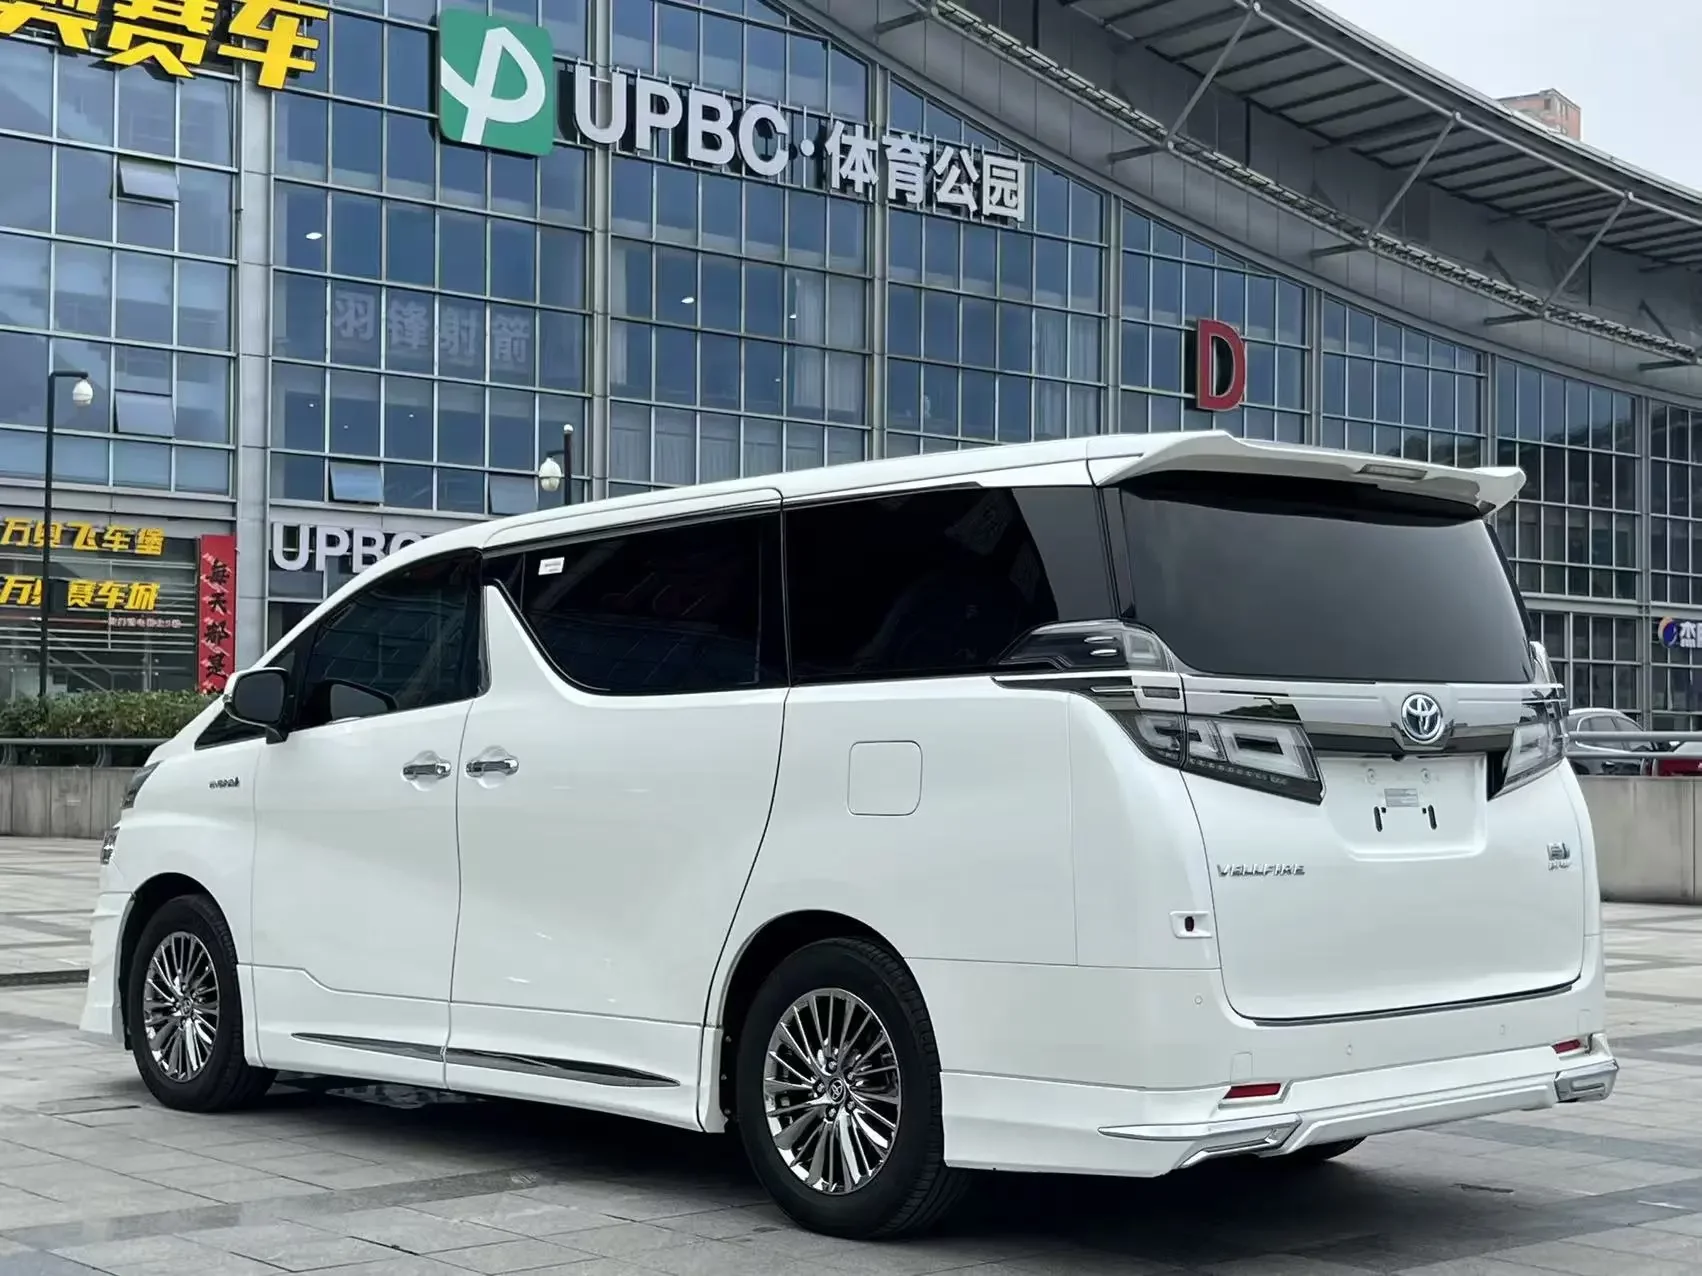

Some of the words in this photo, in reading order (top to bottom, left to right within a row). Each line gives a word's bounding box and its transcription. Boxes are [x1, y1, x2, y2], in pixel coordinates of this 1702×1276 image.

[1196, 318, 1246, 411] D
[203, 556, 234, 695] 每天都是
[1679, 621, 1702, 648] 杰
[1216, 863, 1306, 877] VELLFIRE
